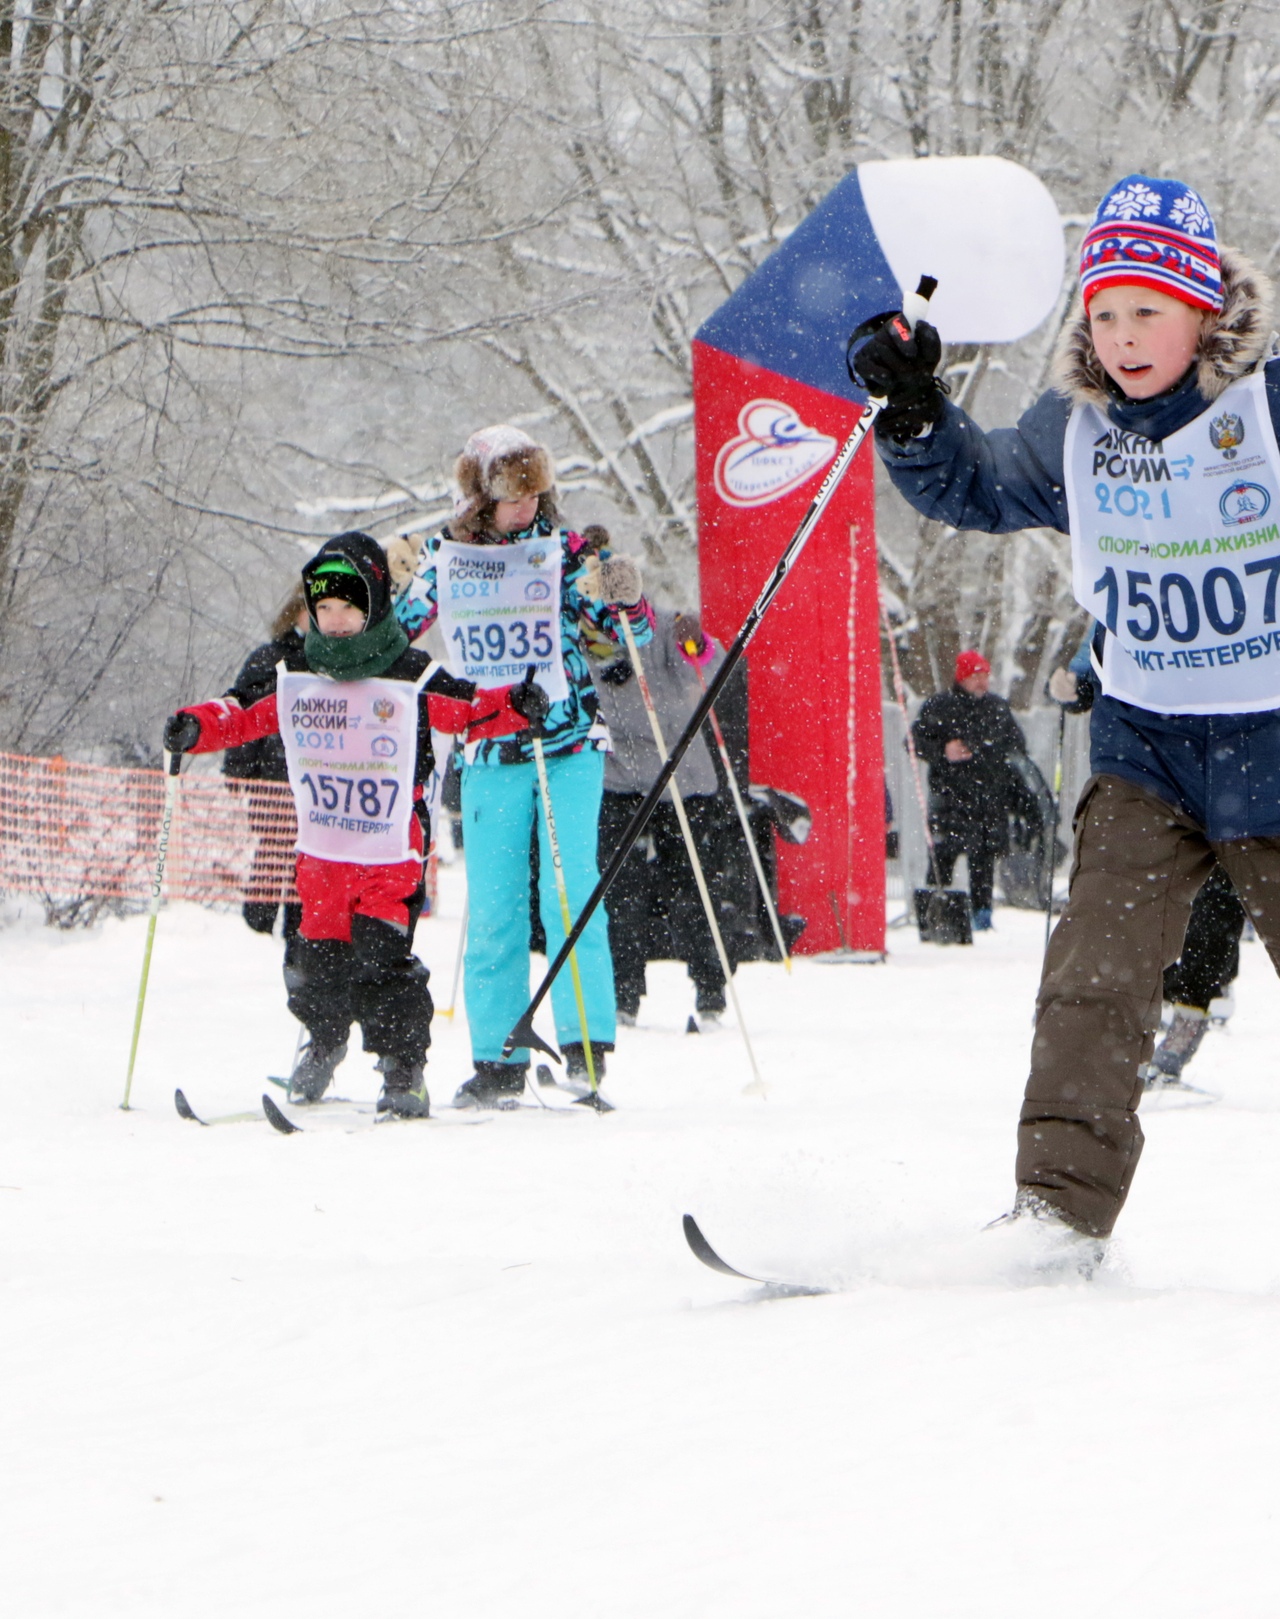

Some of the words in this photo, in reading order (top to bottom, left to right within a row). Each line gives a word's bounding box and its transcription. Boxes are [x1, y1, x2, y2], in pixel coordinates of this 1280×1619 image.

[1094, 482, 1172, 520] 2021
[1098, 535, 1141, 557] СПОРТ
[1149, 537, 1213, 559] НОРМА
[1214, 523, 1280, 553] ЖИЗНИ
[450, 581, 500, 600] 2021
[451, 621, 554, 662] 15935
[290, 698, 349, 714] ЛЫЖНЯ
[291, 714, 348, 730] РОССИИ
[294, 731, 345, 750] 2021
[300, 773, 400, 819] 15787
[309, 810, 394, 835] САНКТ-ПЕТЕРБУРГ
